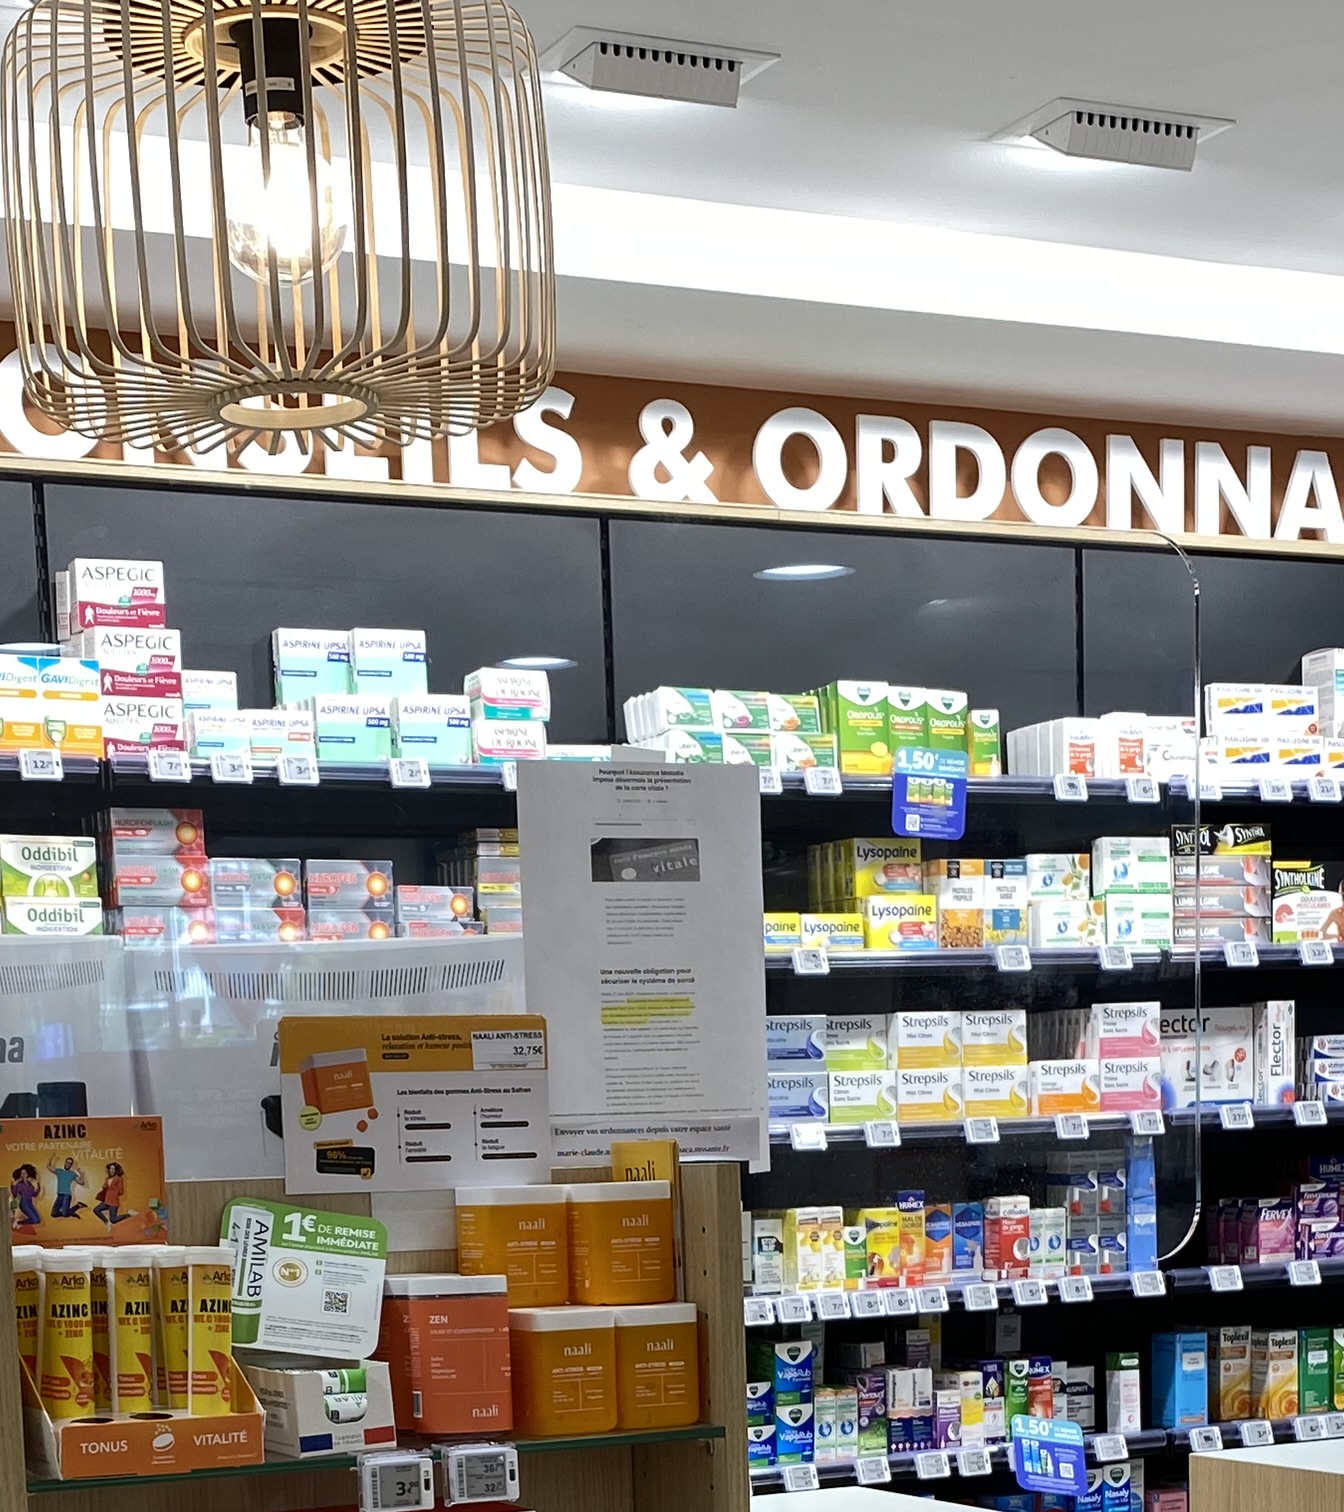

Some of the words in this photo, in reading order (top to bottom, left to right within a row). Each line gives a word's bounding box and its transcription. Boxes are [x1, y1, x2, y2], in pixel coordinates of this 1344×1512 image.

[630, 398, 716, 506] &
[82, 566, 155, 582] ASPEGIC
[96, 606, 131, 616] Douleurs
[138, 608, 161, 618] Fièvre
[101, 633, 173, 650] ASPEGIC
[320, 704, 360, 716] ASPIRINE
[362, 706, 386, 717] UPSA
[22, 846, 79, 863] Oddibil
[857, 844, 917, 861] Lysopaïne
[653, 857, 697, 873] vitale
[27, 906, 85, 924] Oddibil
[902, 1014, 949, 1030] Strepsils
[965, 1013, 1013, 1028] Strepsils
[513, 1046, 543, 1056] 32,75€
[1270, 1022, 1282, 1077] Flector
[43, 1124, 86, 1139] AZINC
[1260, 1207, 1292, 1222] FERVEX
[318, 1224, 332, 1234] DE
[334, 1226, 377, 1239] REMISE
[519, 1218, 545, 1230] naali
[316, 1234, 380, 1252] IMMÉDIATE
[249, 1219, 269, 1298] AMILAB
[429, 1315, 448, 1324] ZEN
[1222, 1331, 1250, 1345] Toplexil
[193, 1430, 248, 1446] VITALITÉ
[80, 1439, 128, 1454] TONUS
